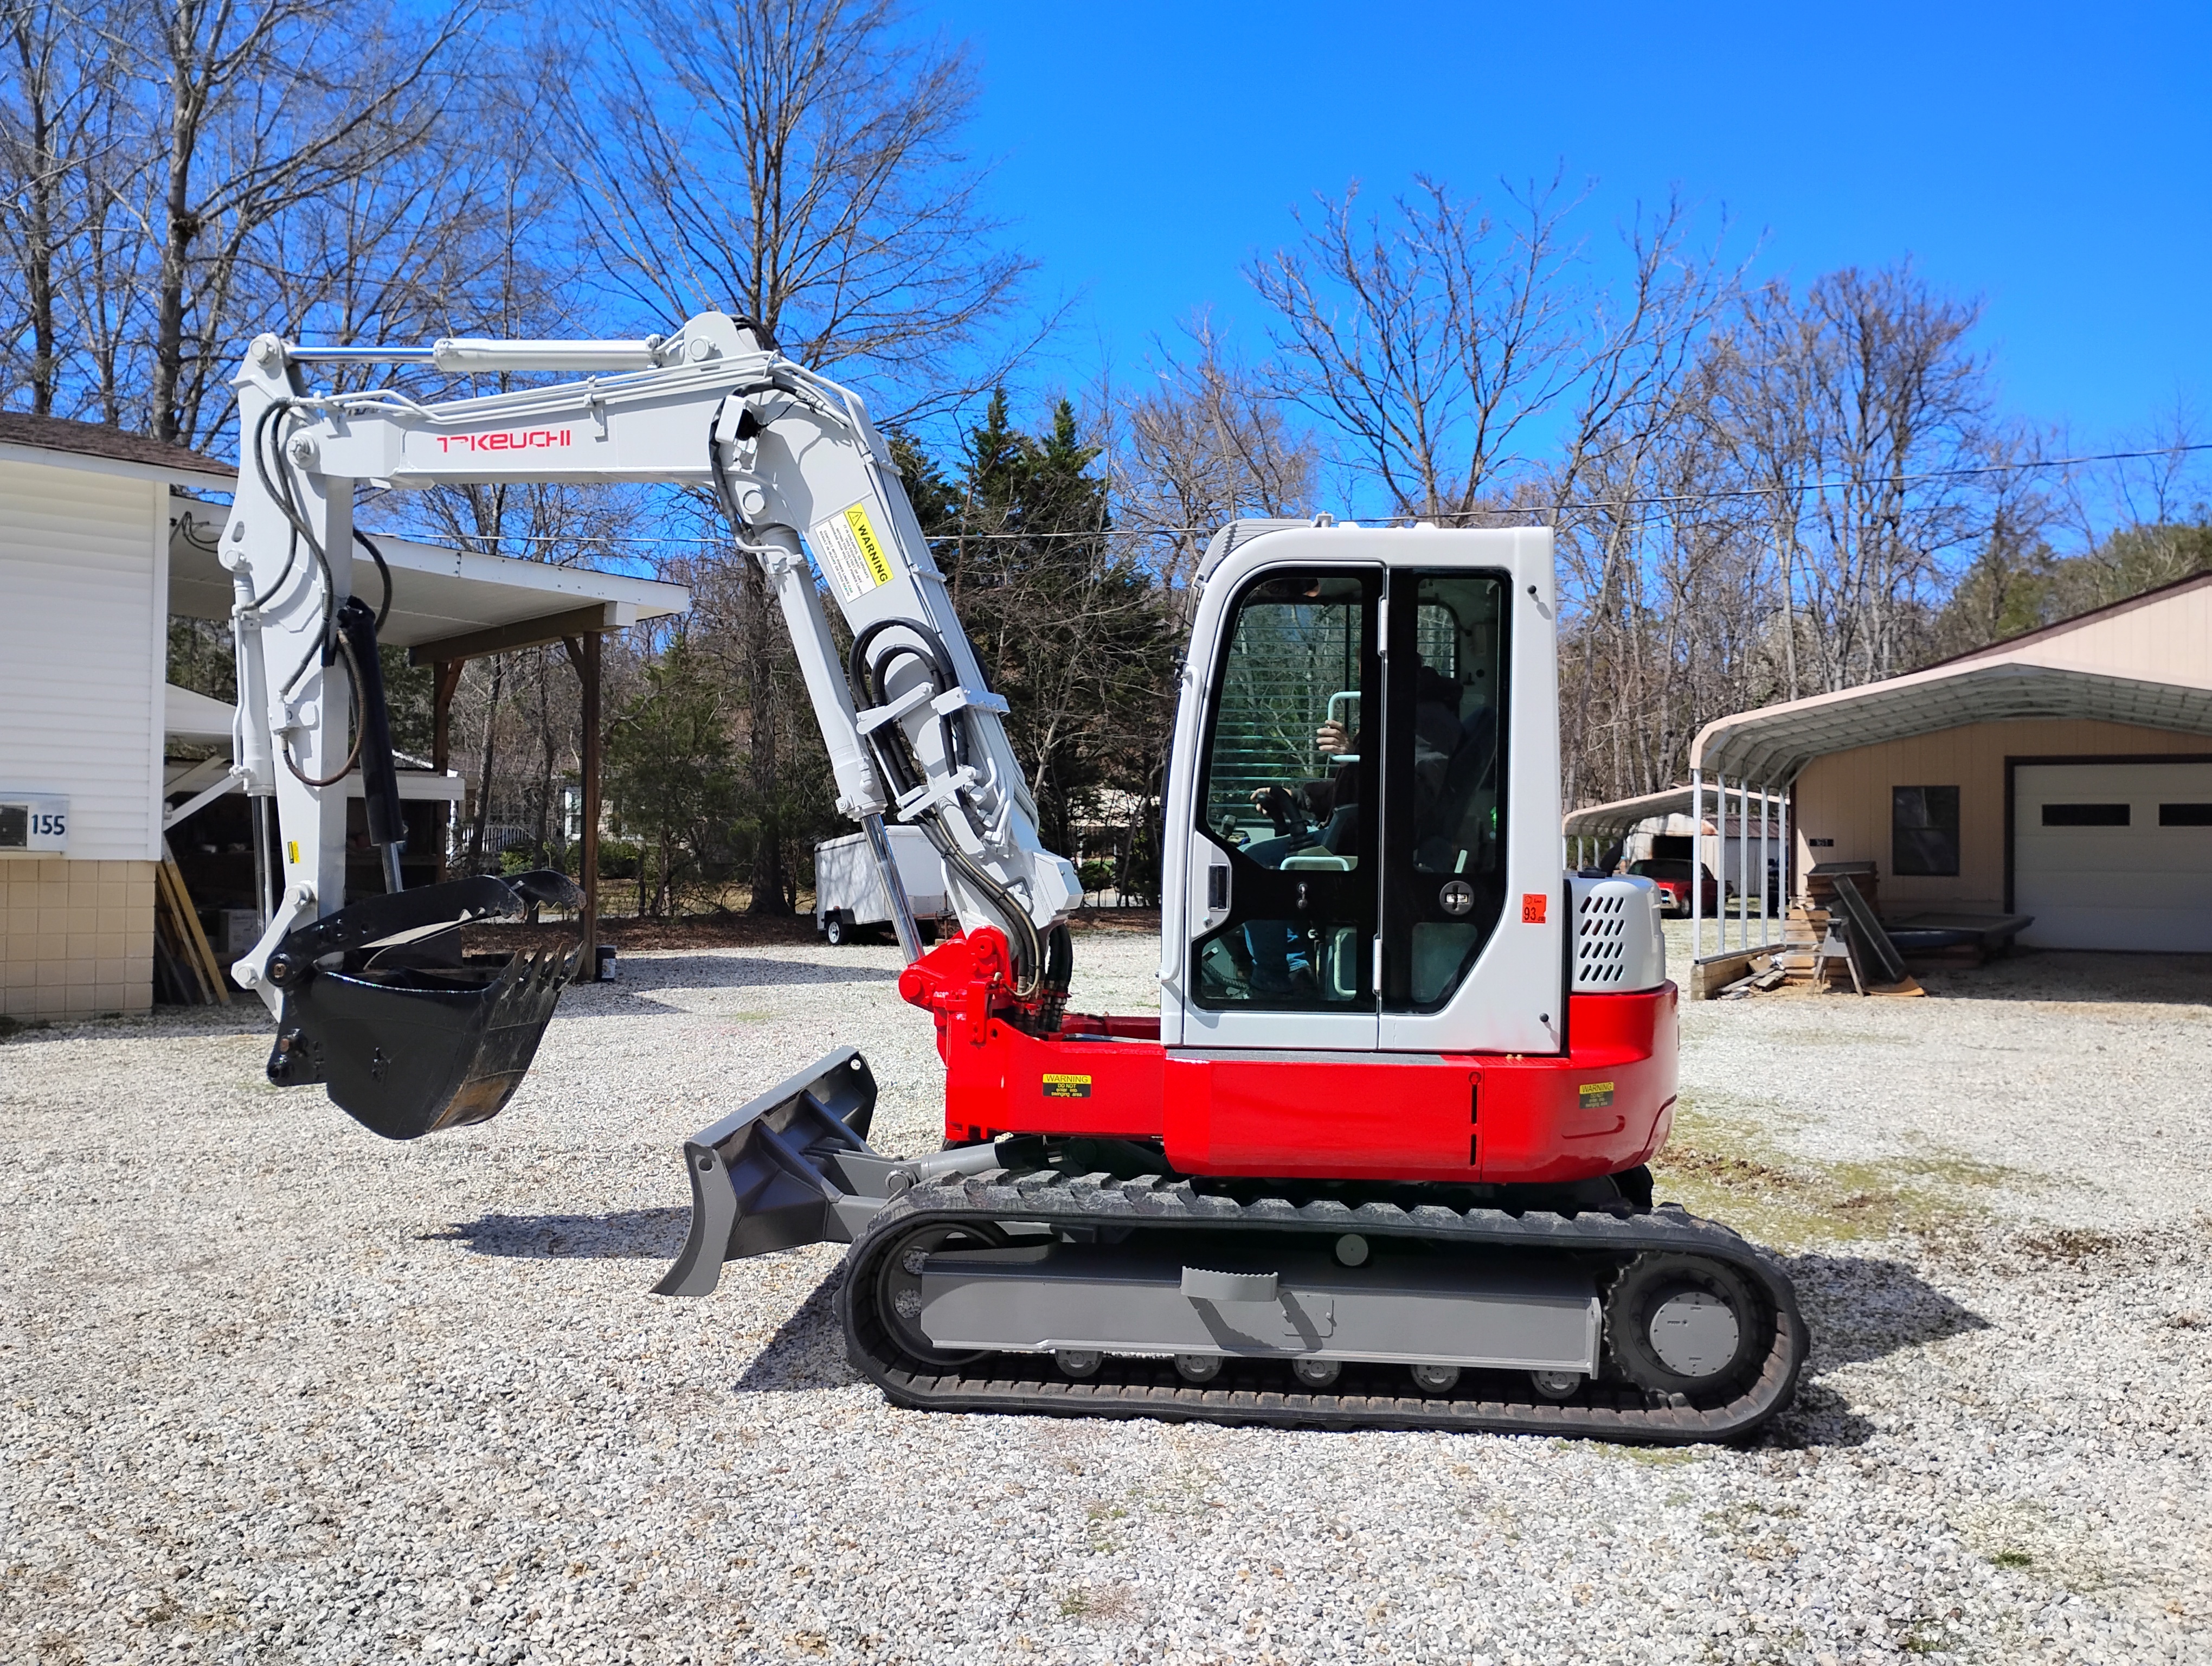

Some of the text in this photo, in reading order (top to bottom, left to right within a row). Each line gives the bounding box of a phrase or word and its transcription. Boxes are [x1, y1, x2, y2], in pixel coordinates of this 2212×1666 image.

[819, 530, 827, 545] RESULT
[824, 530, 833, 548] CONTACT
[847, 534, 858, 554] UNLAWFUL
[859, 561, 869, 578] OPERATE
[849, 547, 860, 569] EQUIPMENT
[858, 524, 888, 582] WARNING
[841, 551, 851, 568] VOLTAGE
[849, 568, 857, 582] POWER
[31, 814, 65, 836] 155
[1523, 906, 1536, 921] 93
[1046, 1075, 1088, 1083] WARNING
[1582, 1082, 1612, 1093] WARNING
